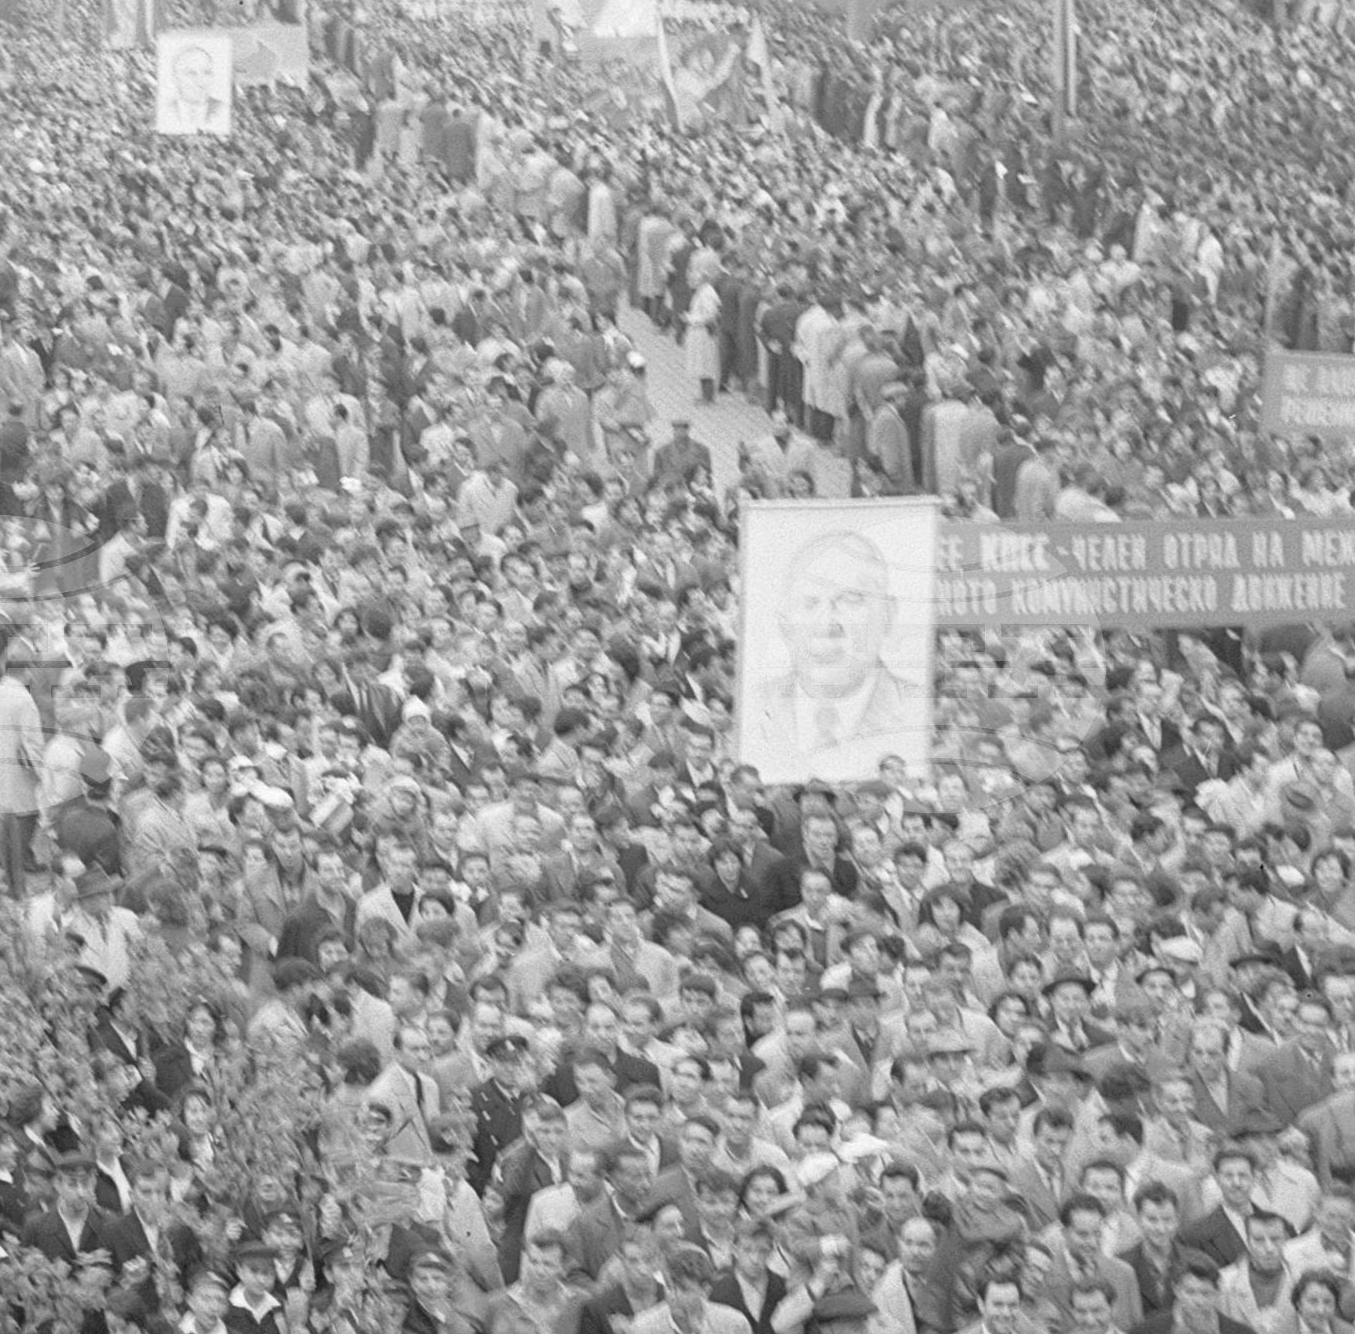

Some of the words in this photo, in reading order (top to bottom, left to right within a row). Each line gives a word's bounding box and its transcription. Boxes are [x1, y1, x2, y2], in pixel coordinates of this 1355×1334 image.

[1163, 531, 1241, 570] ОТРЯД
[1252, 529, 1285, 568] НА
[1230, 571, 1347, 613] ДВИЖЕНИЕ
